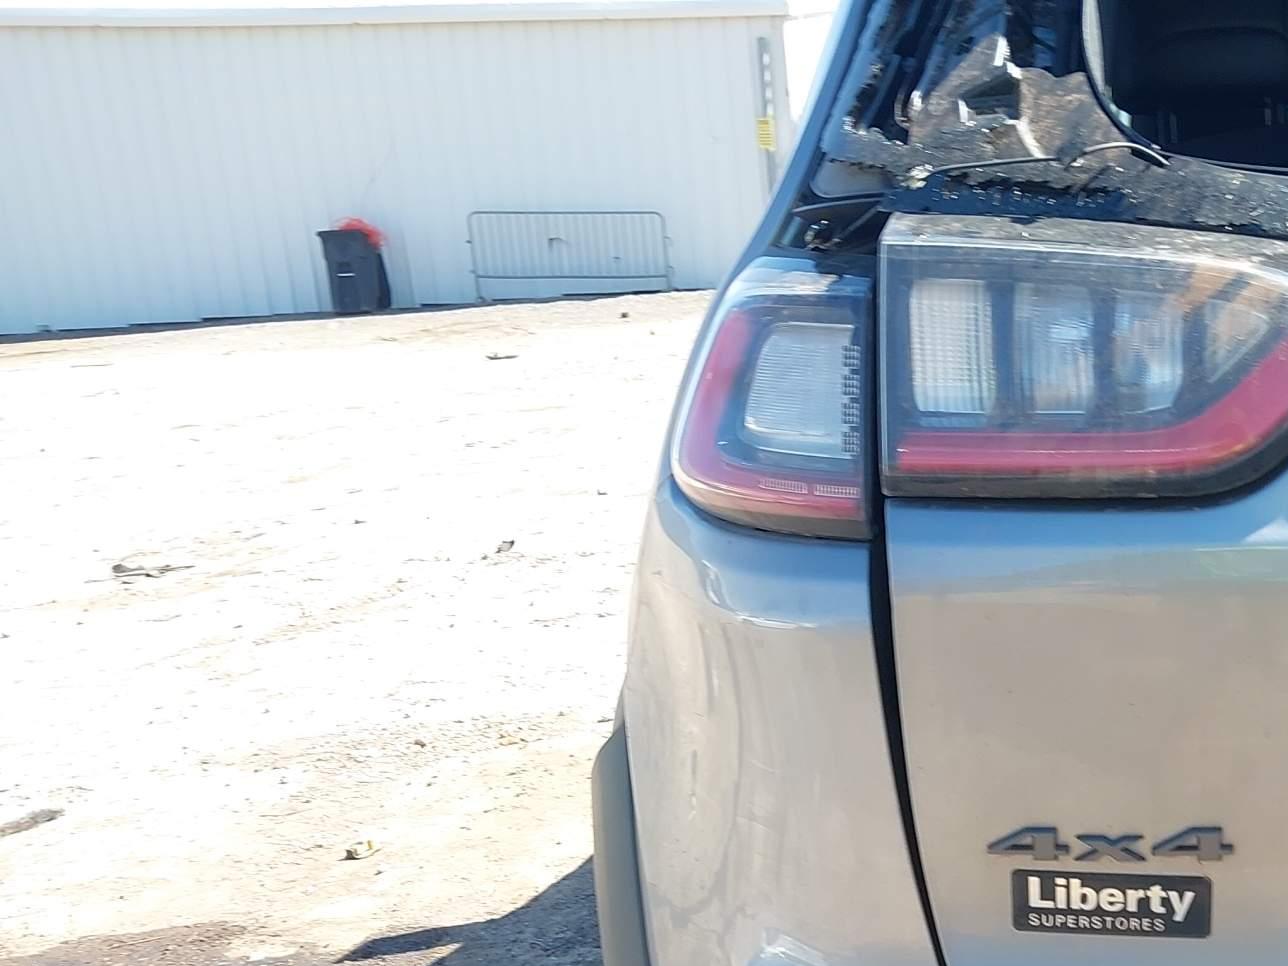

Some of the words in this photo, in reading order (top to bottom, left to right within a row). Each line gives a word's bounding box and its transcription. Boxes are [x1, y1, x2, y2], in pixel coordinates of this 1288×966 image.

[987, 825, 1234, 861] 4x4
[1026, 875, 1196, 923] Liberty
[1027, 912, 1167, 933] SUPERSTORES
